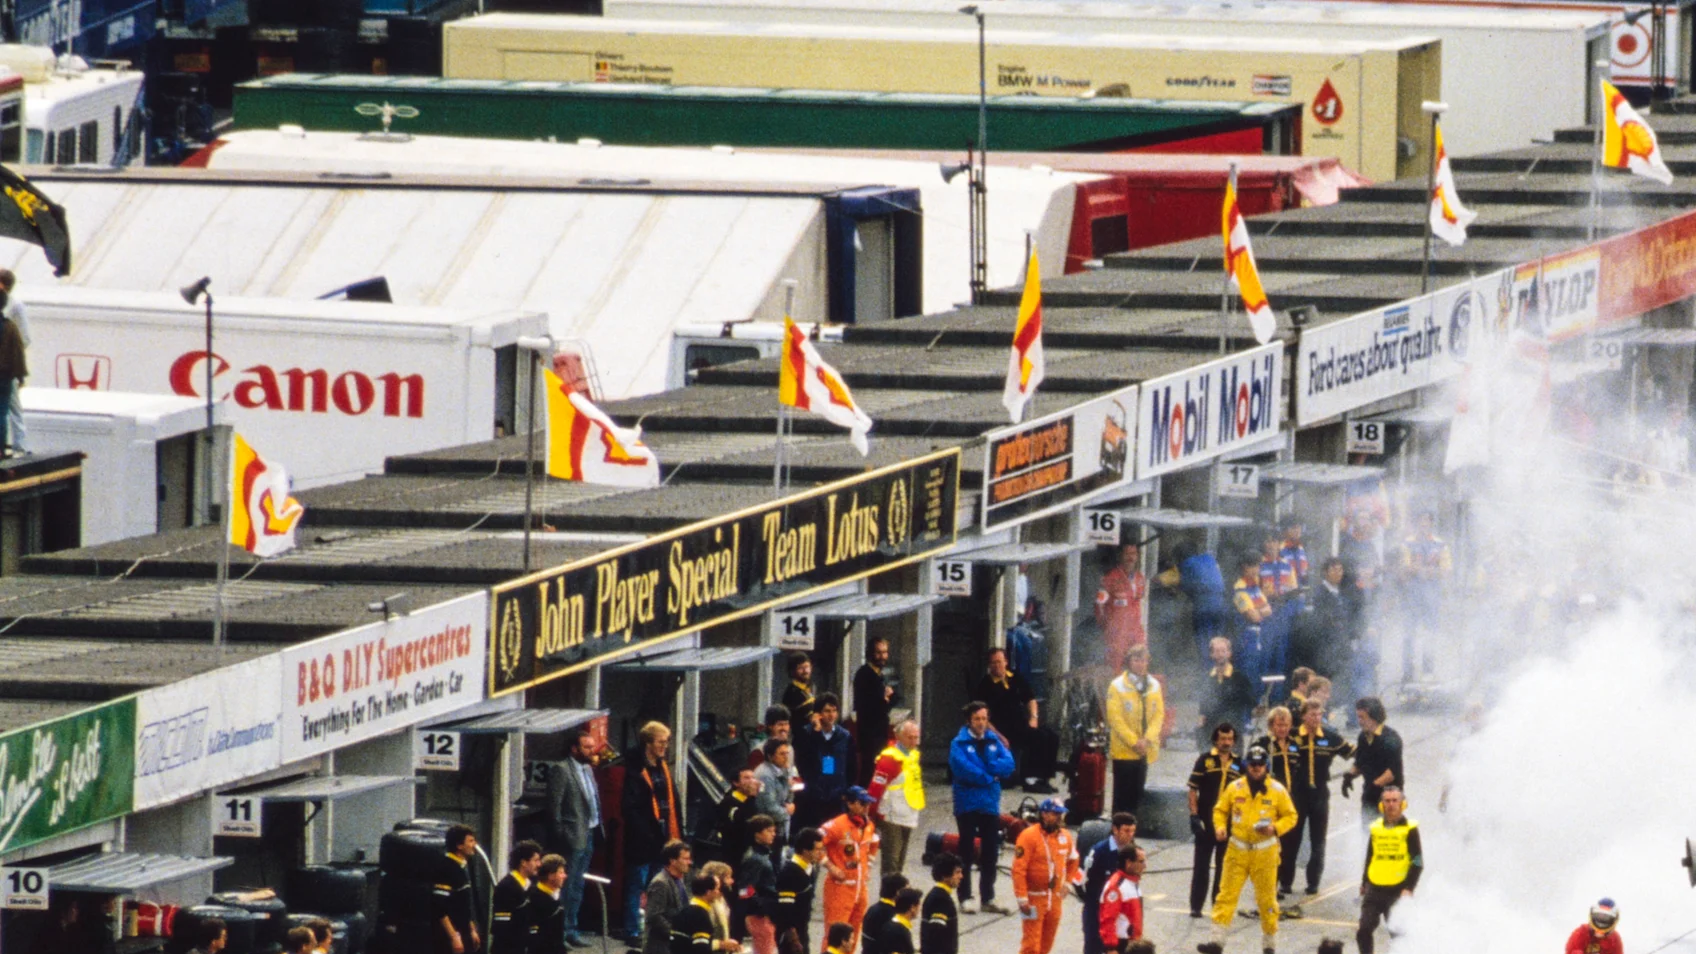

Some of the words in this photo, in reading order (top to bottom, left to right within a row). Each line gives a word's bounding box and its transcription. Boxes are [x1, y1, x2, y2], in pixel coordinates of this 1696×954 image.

[998, 74, 1033, 87] BMW
[1037, 75, 1048, 86] M
[1591, 342, 1620, 358] 20
[1307, 346, 1335, 396] Ford
[169, 350, 424, 418] Canon
[1149, 373, 1209, 468] Mobil
[1218, 353, 1274, 446] Mobil
[1353, 424, 1379, 442] 18
[1229, 467, 1254, 483] 17
[1089, 513, 1115, 531] 16
[535, 576, 584, 659] John
[593, 558, 659, 643] Player
[667, 522, 739, 626] Special
[763, 511, 816, 584] Team
[825, 492, 878, 565] Lotus
[938, 562, 964, 581] 15
[782, 615, 809, 635] 14
[297, 652, 335, 707] B&Q
[378, 624, 470, 690] Supercentres
[303, 707, 350, 742] Everything
[352, 700, 364, 725] For
[368, 695, 382, 721] The
[449, 670, 463, 694] Car
[423, 733, 453, 755] 12
[226, 799, 251, 821] 11
[8, 870, 43, 893] 10
